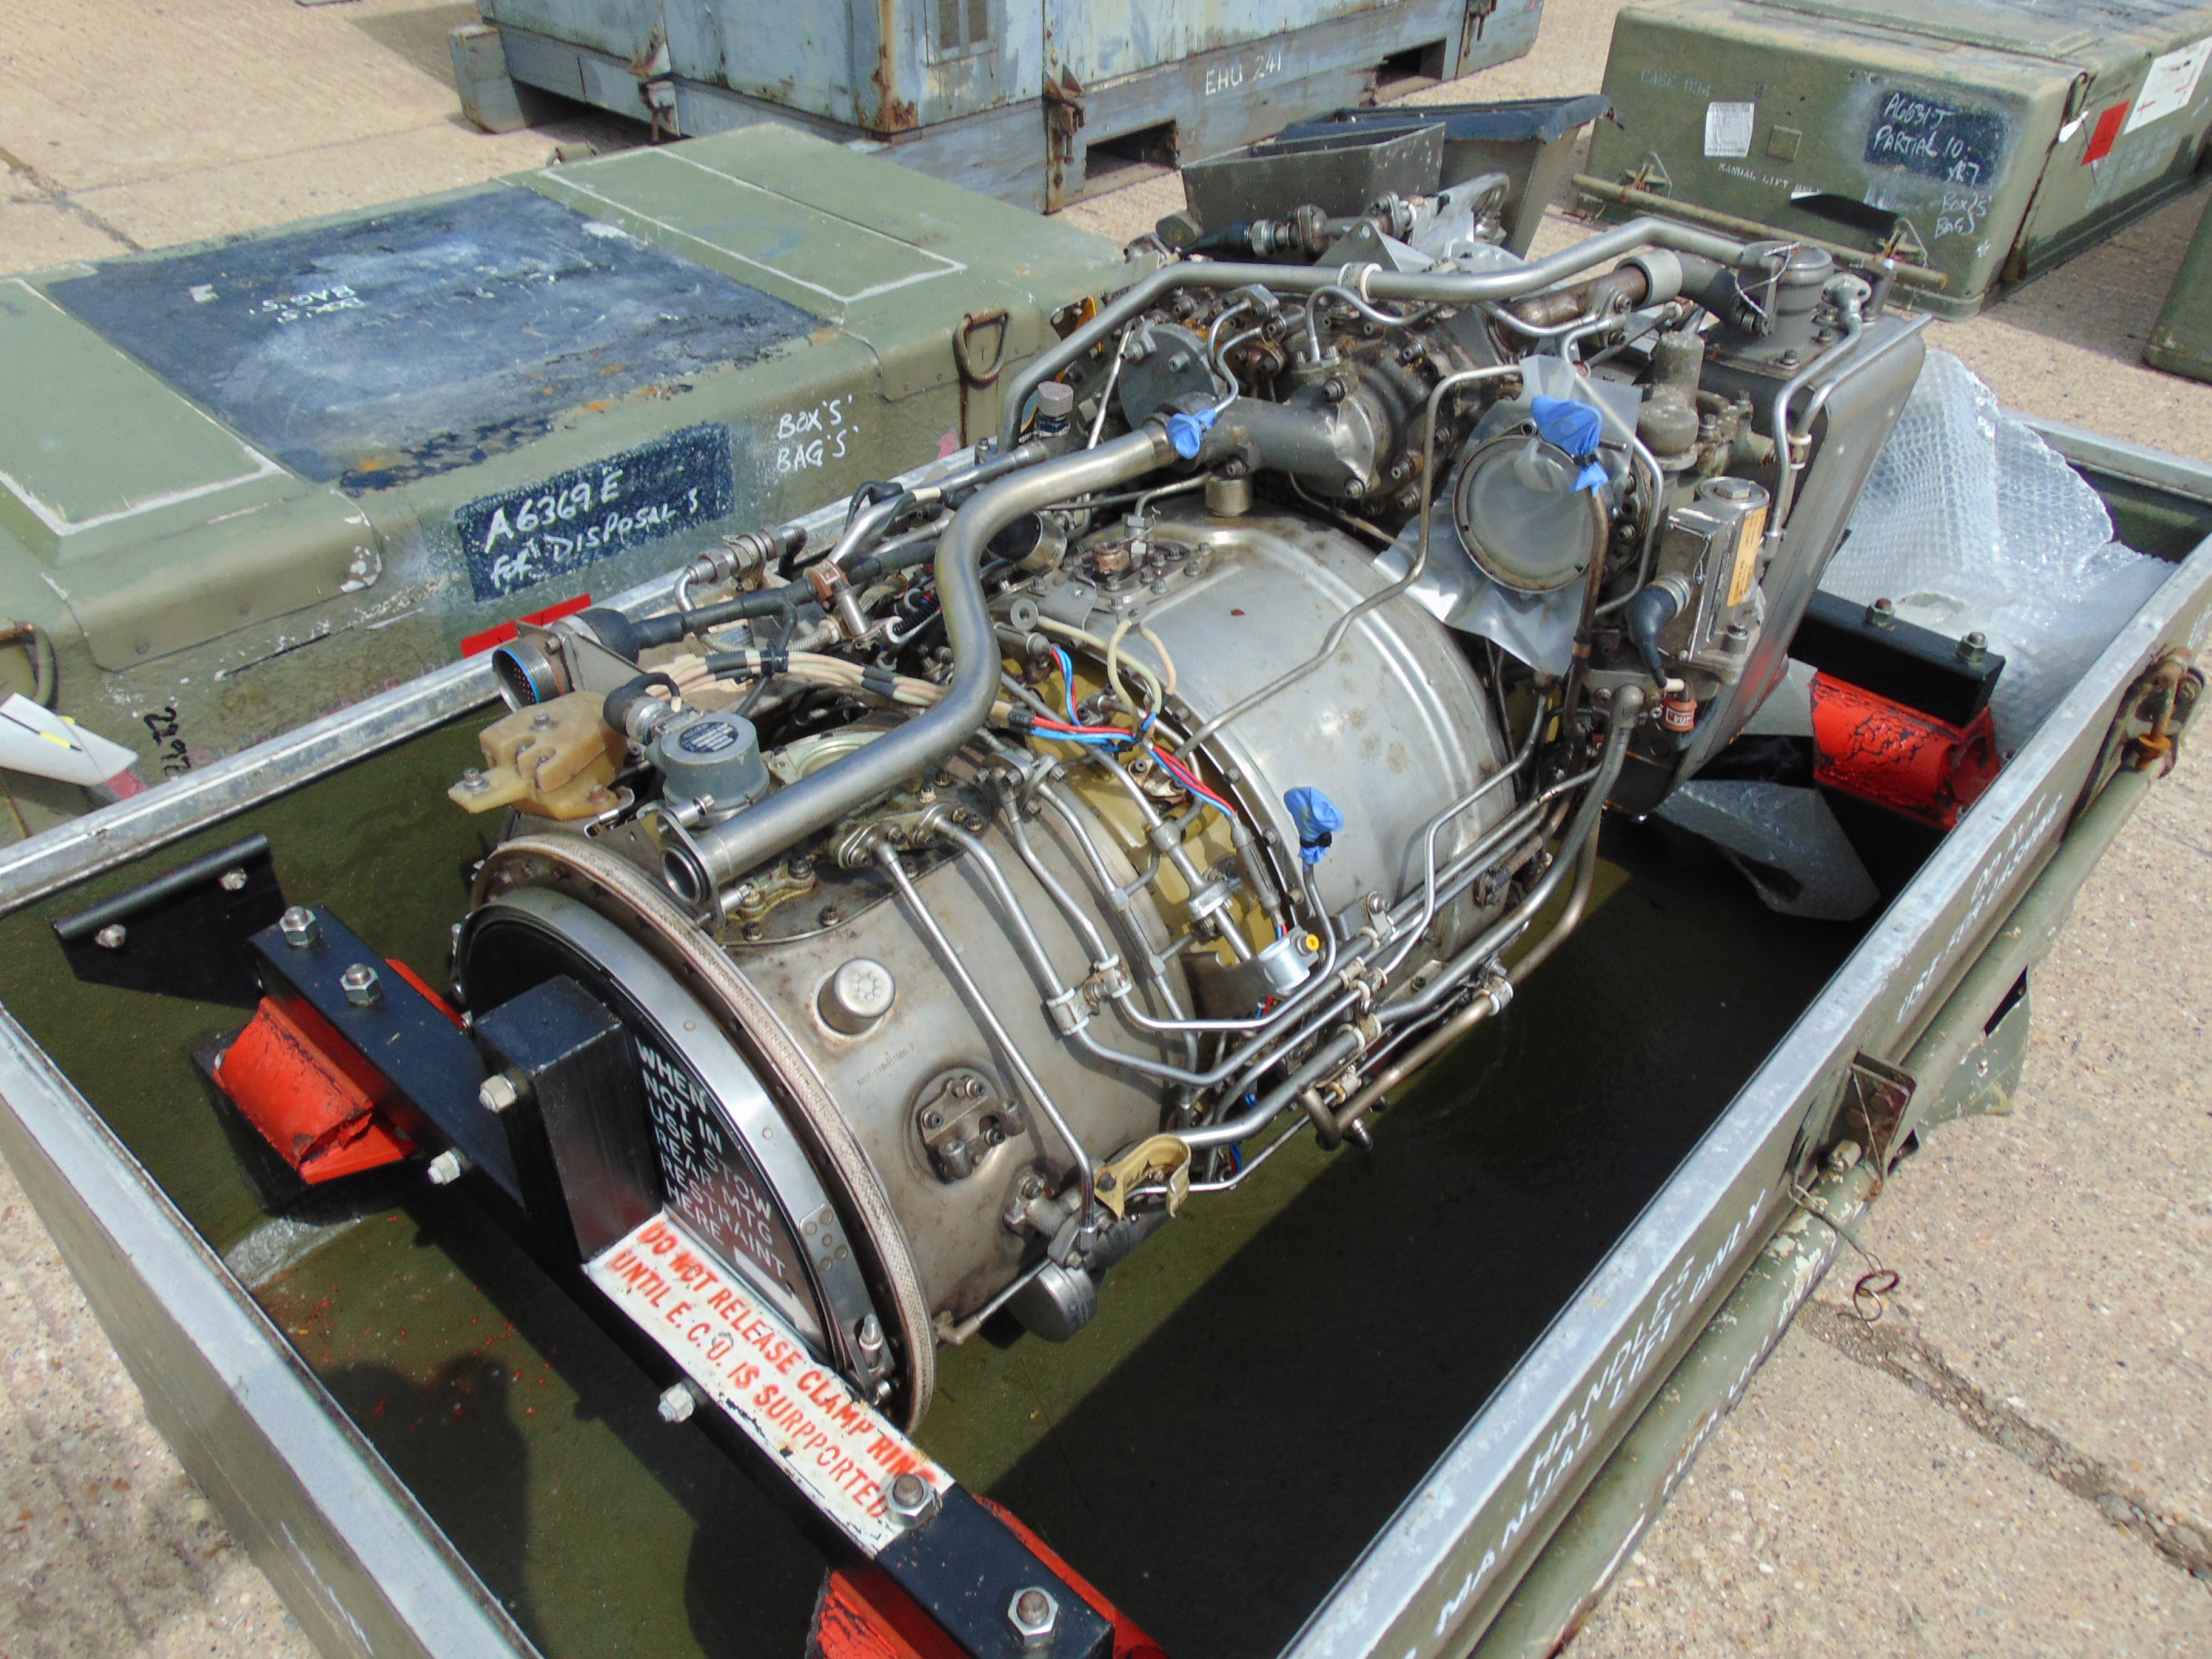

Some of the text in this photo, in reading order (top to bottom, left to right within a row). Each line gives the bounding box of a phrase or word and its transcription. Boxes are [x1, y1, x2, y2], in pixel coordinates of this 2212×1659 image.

[1253, 50, 1281, 81] 241
[1718, 161, 1757, 181] MANUAL
[635, 1034, 708, 1115] WHEN
[642, 1068, 723, 1153] NOT IN
[648, 1097, 772, 1221] USE STOW
[654, 1125, 773, 1246] REAR MTG
[660, 1151, 786, 1278] RESTRAINT
[665, 1178, 725, 1246] HERE
[609, 1250, 669, 1309] UNTIL
[726, 1361, 760, 1390] IS
[752, 1383, 891, 1518] SURPPORTED
[637, 1219, 679, 1256] DO
[669, 1249, 720, 1293] NOT
[707, 1287, 803, 1376] RELEASE
[796, 1368, 876, 1441] CLAMP
[1527, 1255, 1695, 1488] HANDLES
[1435, 1421, 1592, 1636] MANUAL
[1608, 1299, 1682, 1410] LIFT
[1689, 1188, 1766, 1303] ONLY
